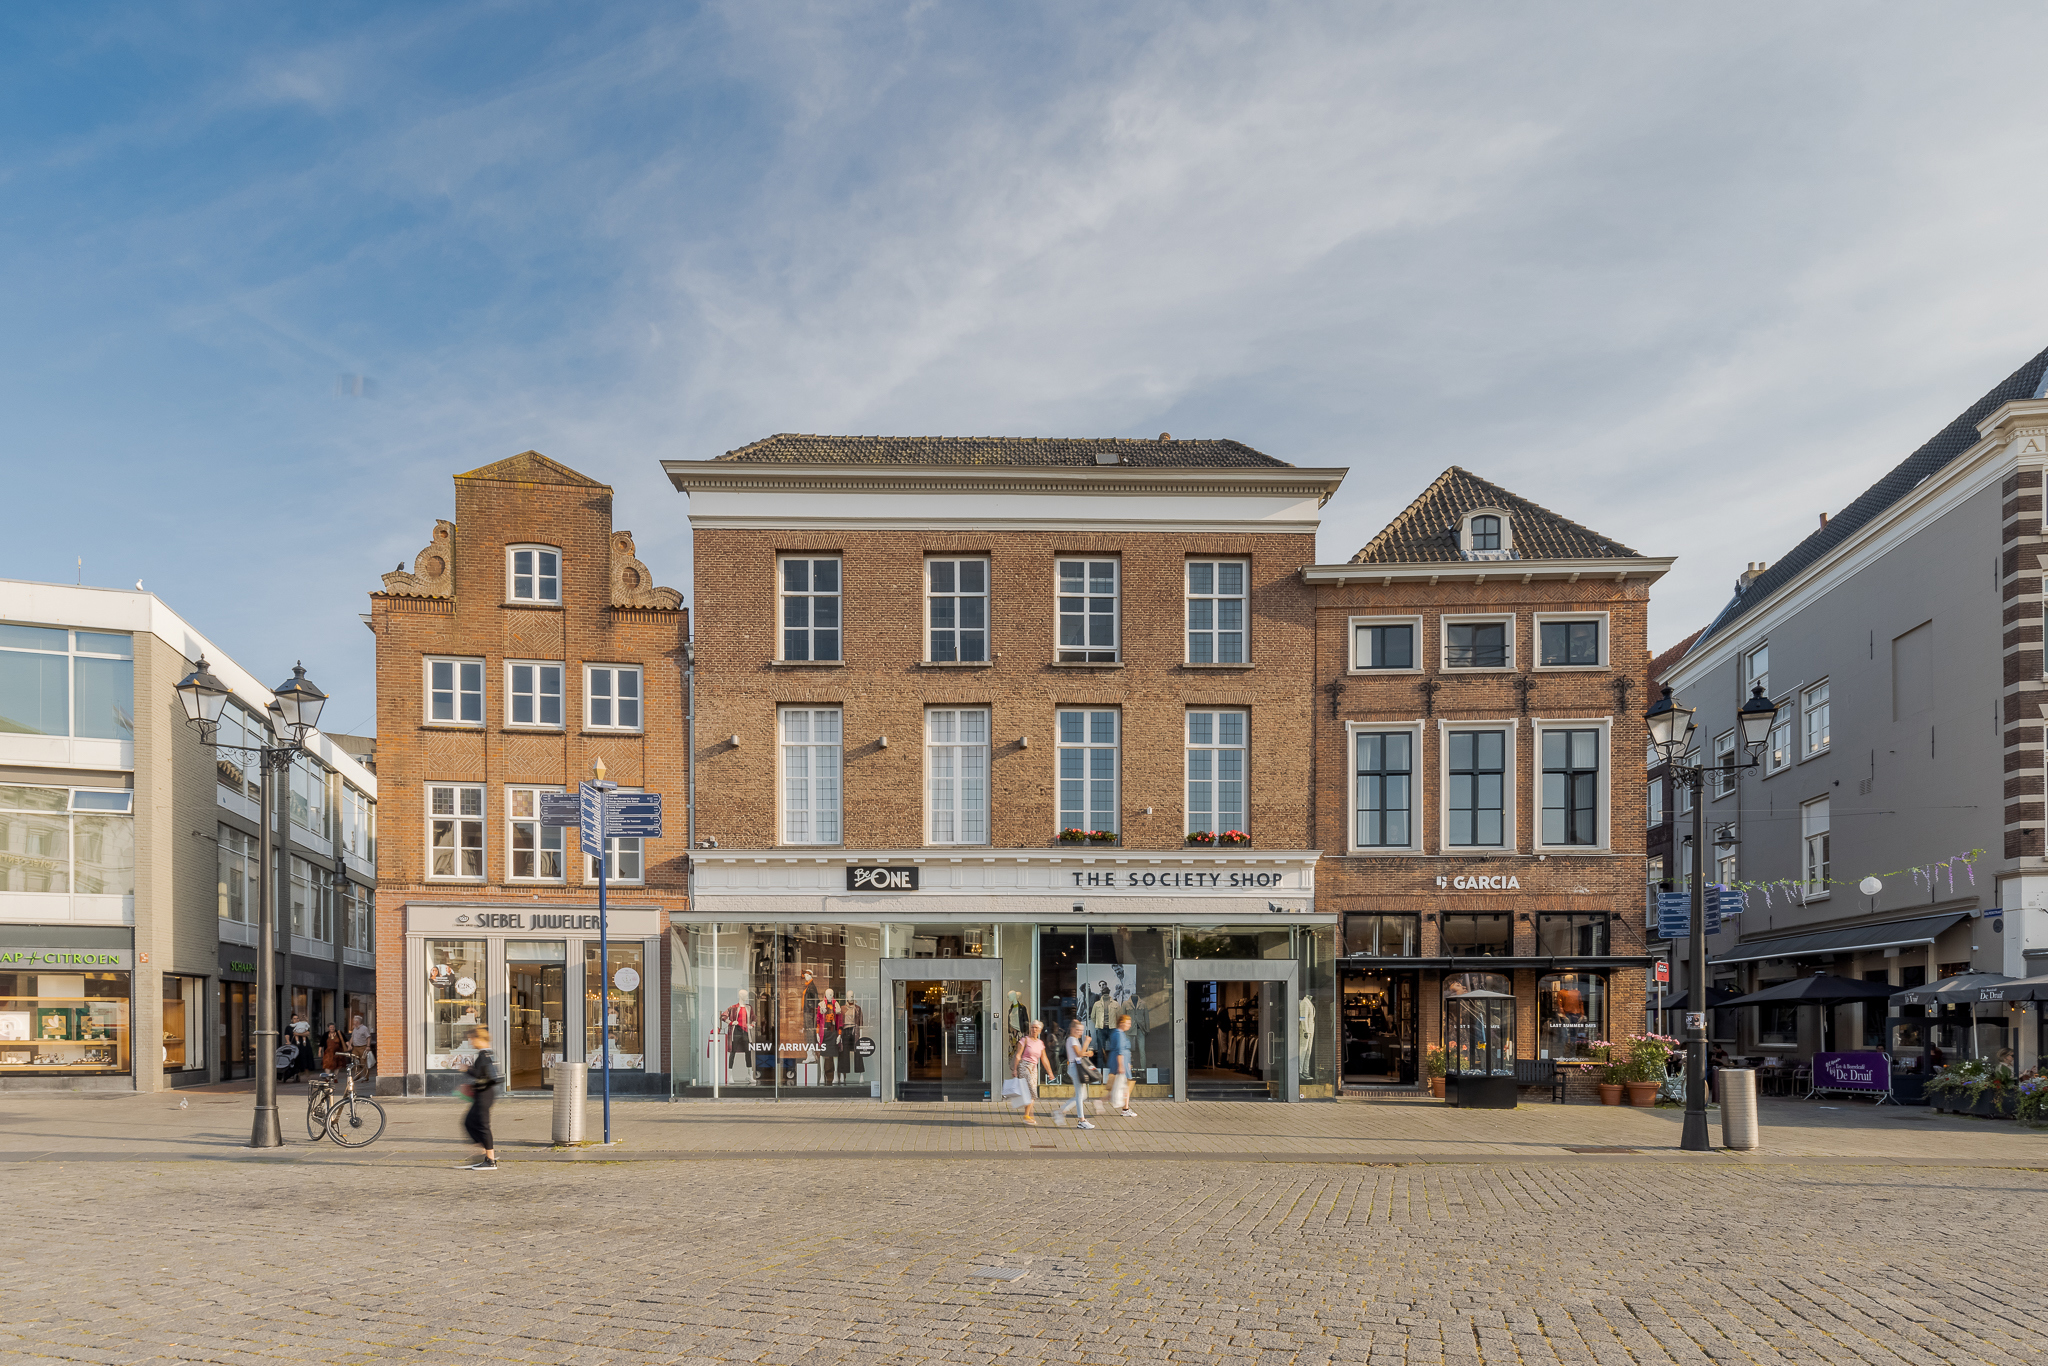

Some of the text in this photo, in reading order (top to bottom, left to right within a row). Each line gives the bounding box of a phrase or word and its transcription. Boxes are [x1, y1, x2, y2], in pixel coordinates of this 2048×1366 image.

[1072, 872, 1283, 887] THE SOCIETY SHOP
[1453, 875, 1520, 890] GARCIA
[476, 913, 526, 929] SIEBEL
[43, 952, 120, 964] CITROEN
[748, 1042, 827, 1052] NEW ARRIVALS
[1836, 1069, 1874, 1081] De Druif
